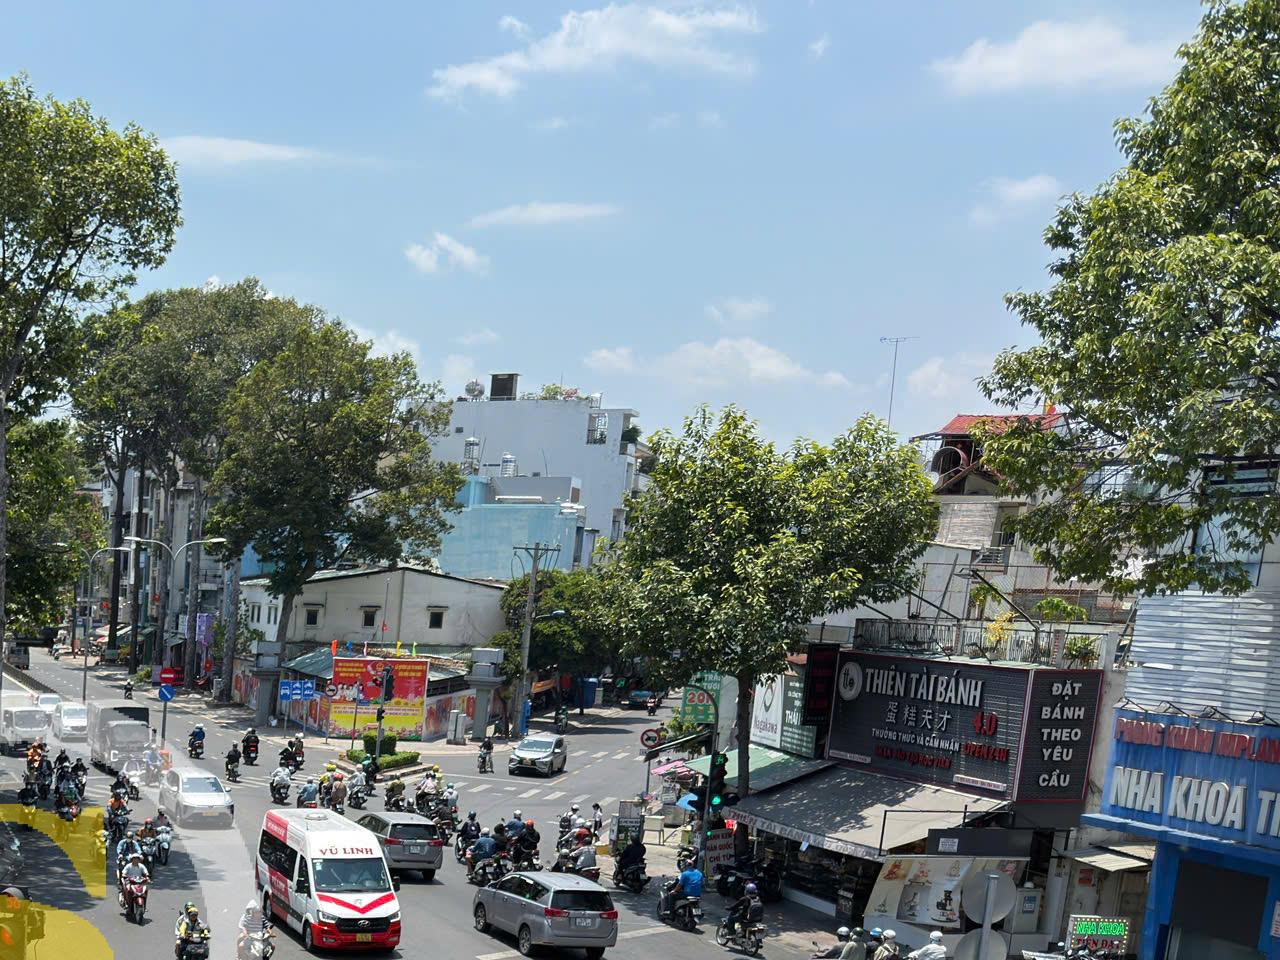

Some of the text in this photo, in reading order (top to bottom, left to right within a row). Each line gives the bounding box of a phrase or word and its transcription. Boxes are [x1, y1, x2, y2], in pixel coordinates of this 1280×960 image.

[865, 664, 907, 697] THIÊN
[910, 666, 937, 701] TÀI
[936, 669, 984, 707] BÁNH
[1052, 680, 1082, 700] ĐẶT
[1041, 703, 1085, 720] BÁNH
[1041, 728, 1082, 742] THEO
[1042, 745, 1073, 762] YÊU
[1038, 769, 1070, 787] CẦU
[1110, 765, 1165, 815] NHA
[1168, 775, 1248, 831] KHOA
[343, 847, 374, 856] LINH
[1076, 921, 1125, 936] NHA KHOA
